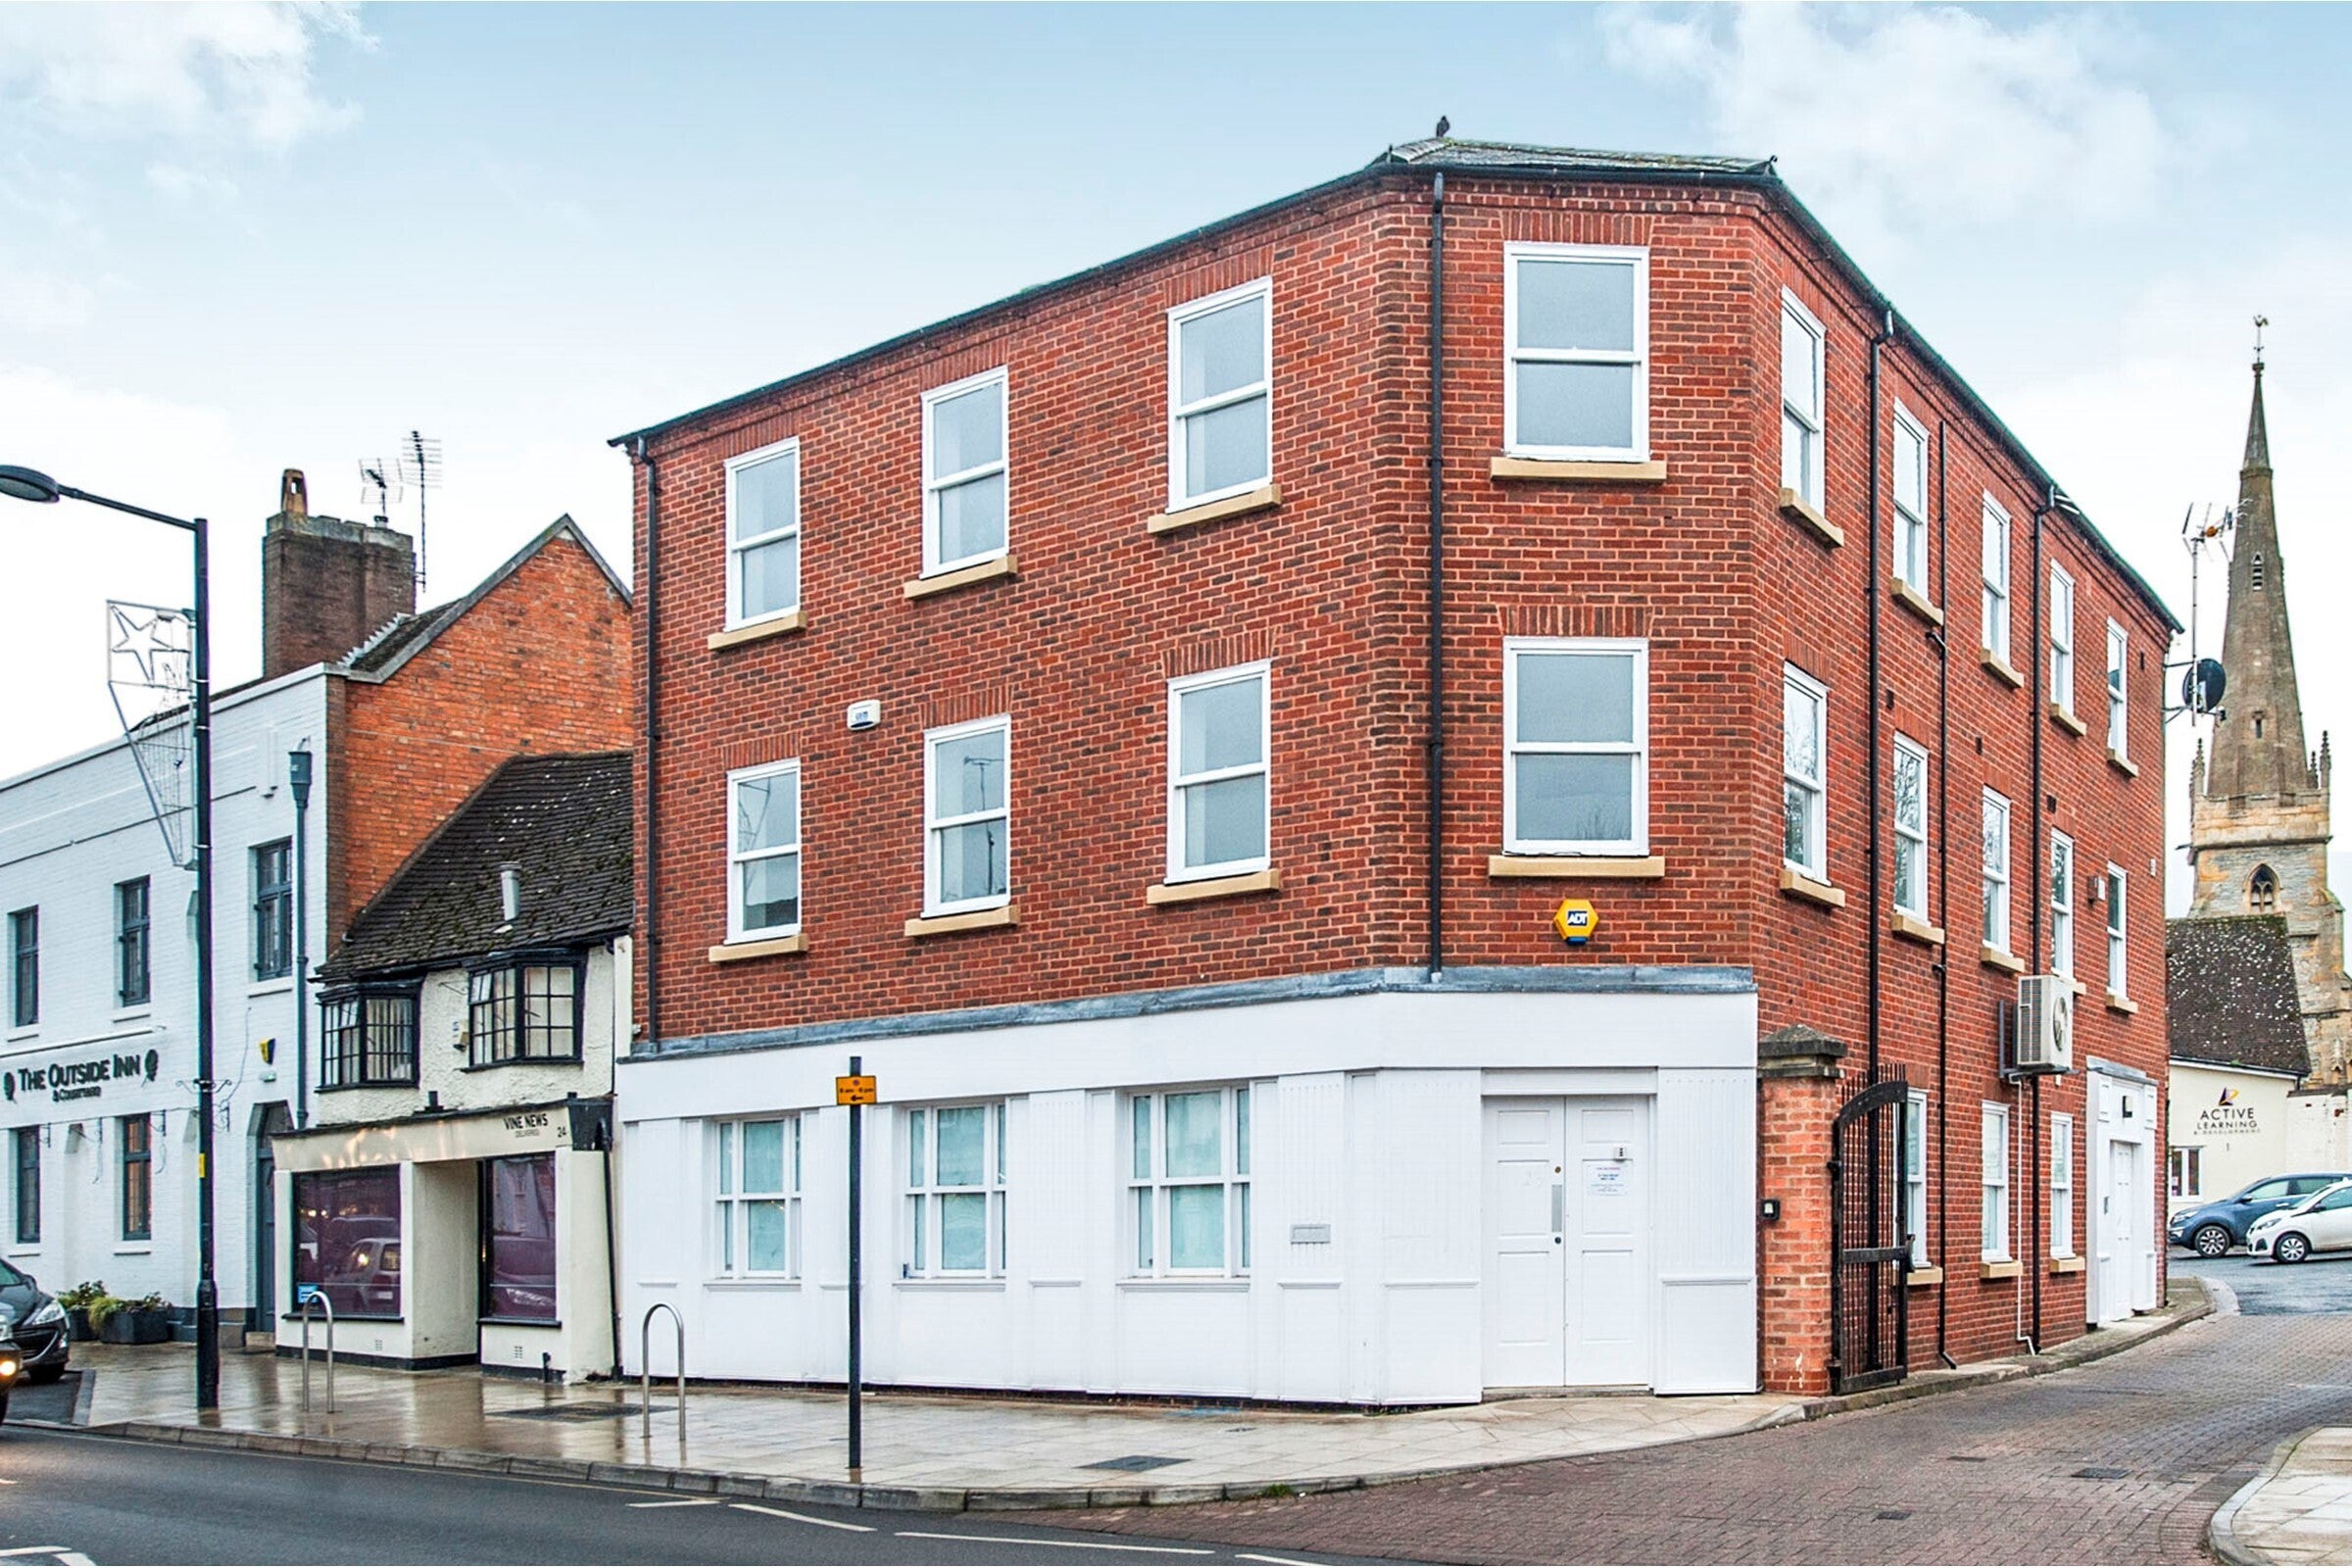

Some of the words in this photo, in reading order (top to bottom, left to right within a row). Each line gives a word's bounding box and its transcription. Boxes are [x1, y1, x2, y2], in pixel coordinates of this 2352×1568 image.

[1568, 912, 1588, 924] ADT
[18, 1068, 46, 1092] THE
[48, 1059, 110, 1088] OUTSIDE
[113, 1054, 140, 1079] INN
[2200, 1107, 2254, 1121] ACTIVE
[503, 1116, 523, 1130] VINE
[524, 1113, 548, 1128] NEWS
[2196, 1120, 2258, 1130] LEARNING
[557, 1126, 566, 1138] 24
